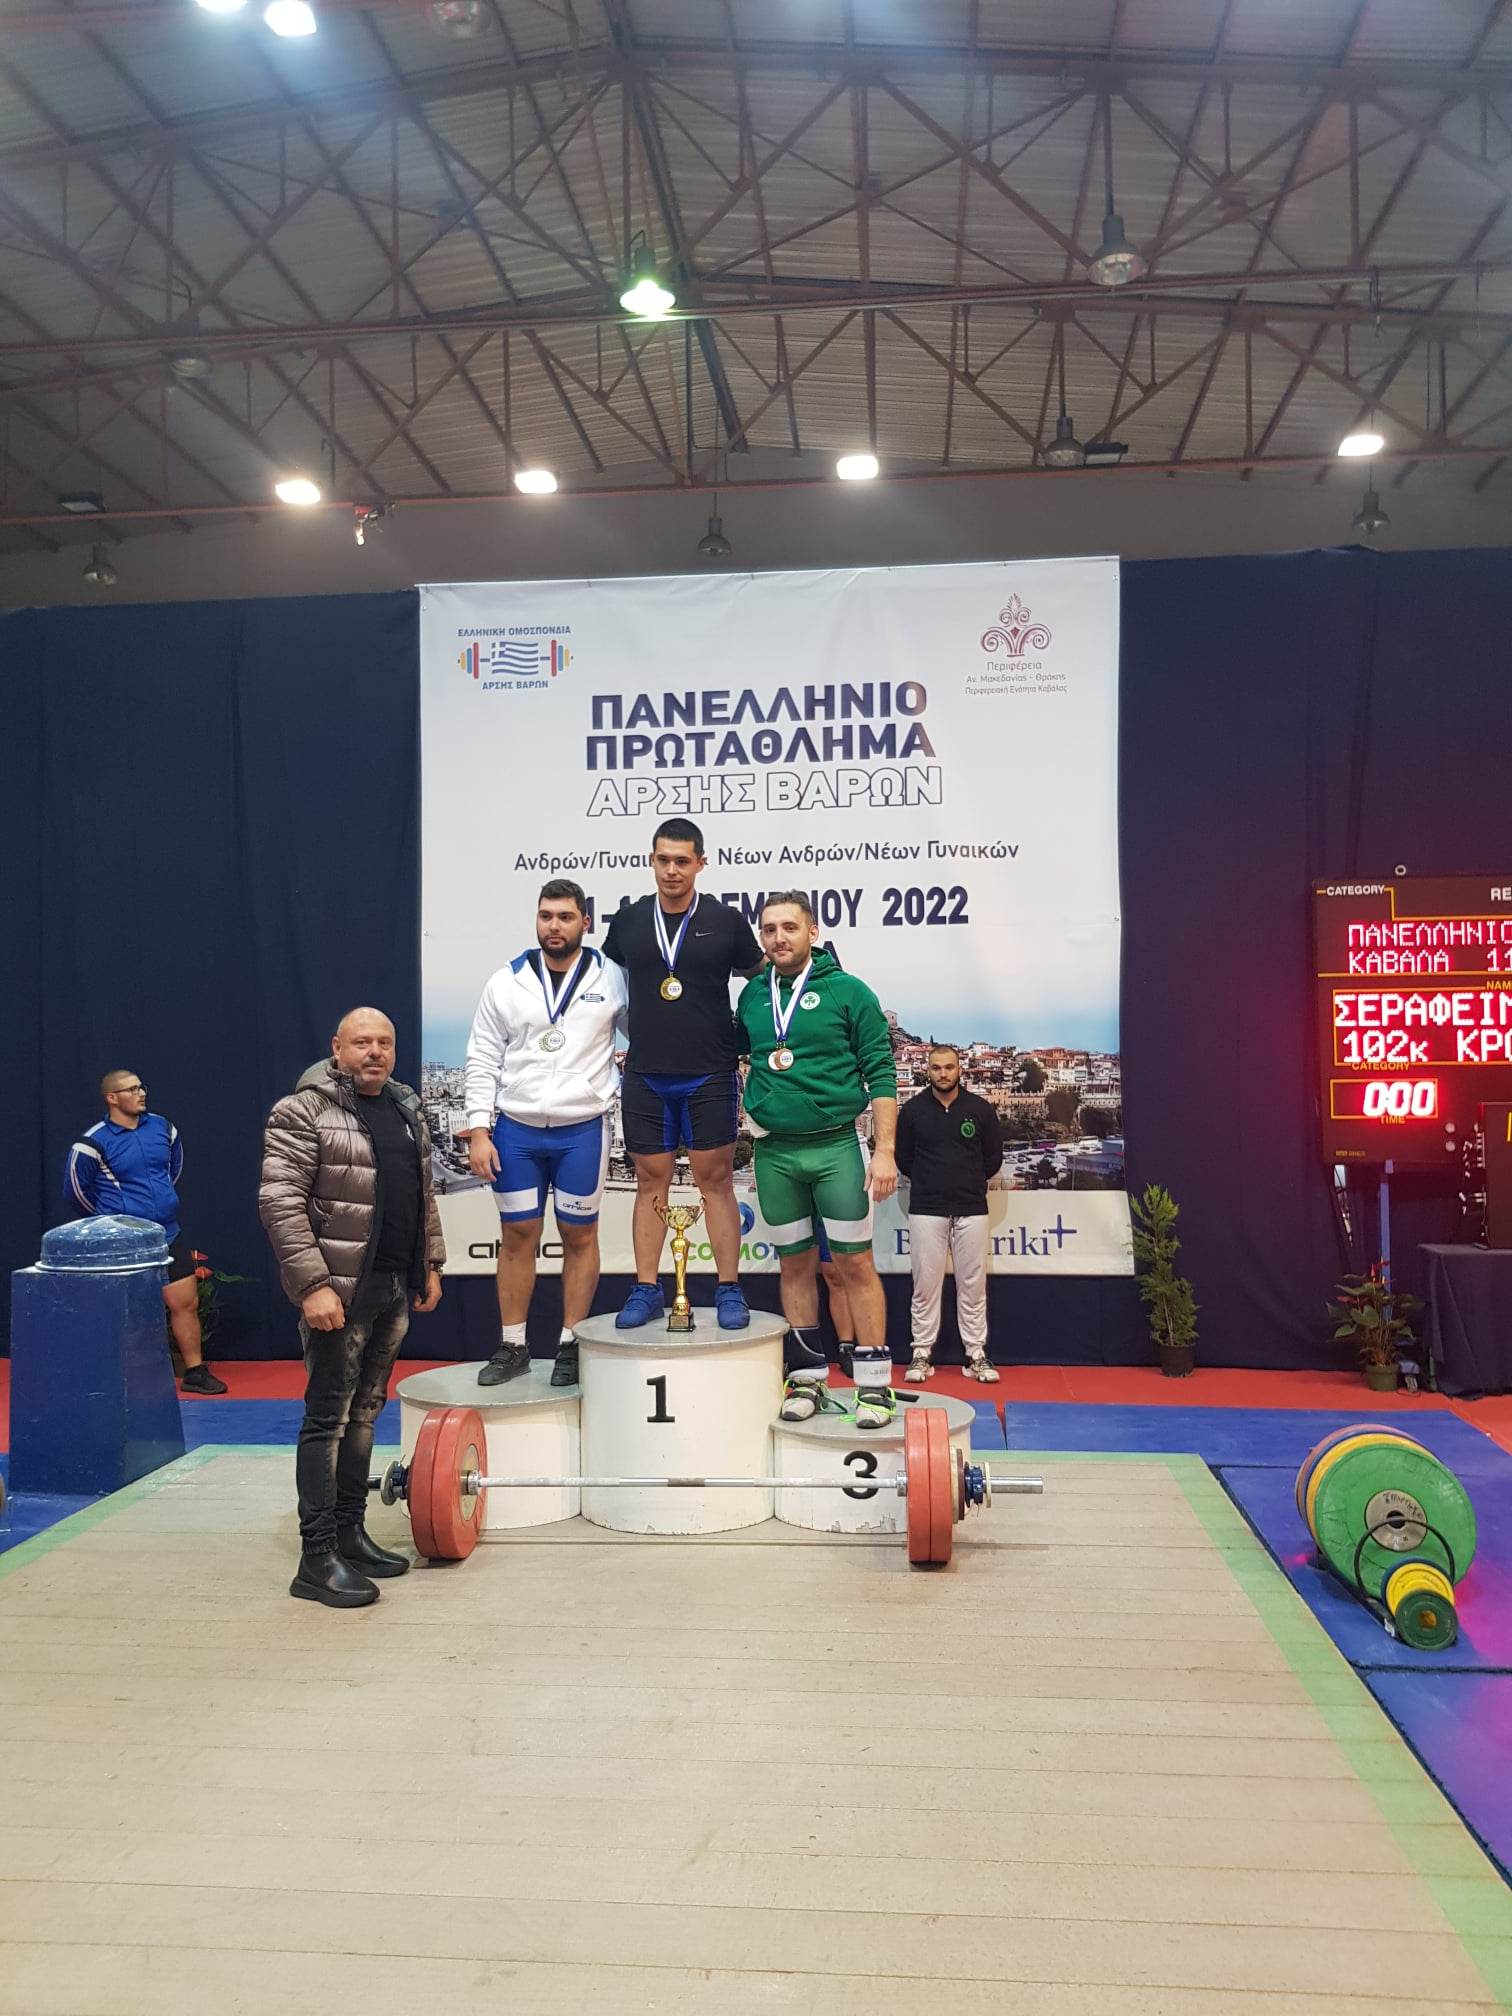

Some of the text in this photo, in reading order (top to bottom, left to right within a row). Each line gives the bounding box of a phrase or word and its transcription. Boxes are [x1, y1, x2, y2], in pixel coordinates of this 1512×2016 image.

[457, 626, 572, 637] ΕΛΛΗΝΙΚΗ ΟΜΟΣΠΟΝΔΙΑ
[986, 660, 1042, 672] Περιφέρεια
[482, 680, 549, 690] ΑΡΣΗΣ ΒΑΡΩΝ
[592, 681, 927, 730] ΠΑΝΕΛΛΗΝΙΟ
[586, 722, 936, 770] ΠΡΩΤΑΘΛΗΜΑ
[586, 766, 943, 817] ΑΡΣΗΣ ΒΑΡΩΝ
[514, 851, 653, 874] Ανδρών/Γυναι
[718, 847, 773, 866] Νέων
[778, 842, 921, 867] Ανδρών/Νέων
[927, 840, 1020, 860] Γυναικών
[882, 885, 969, 926] 2022
[1326, 884, 1386, 897] CATEGORY
[1349, 949, 1450, 975] ΚΑΒΑΛΑ
[646, 1374, 675, 1424] 1
[841, 1450, 880, 1500] 3
